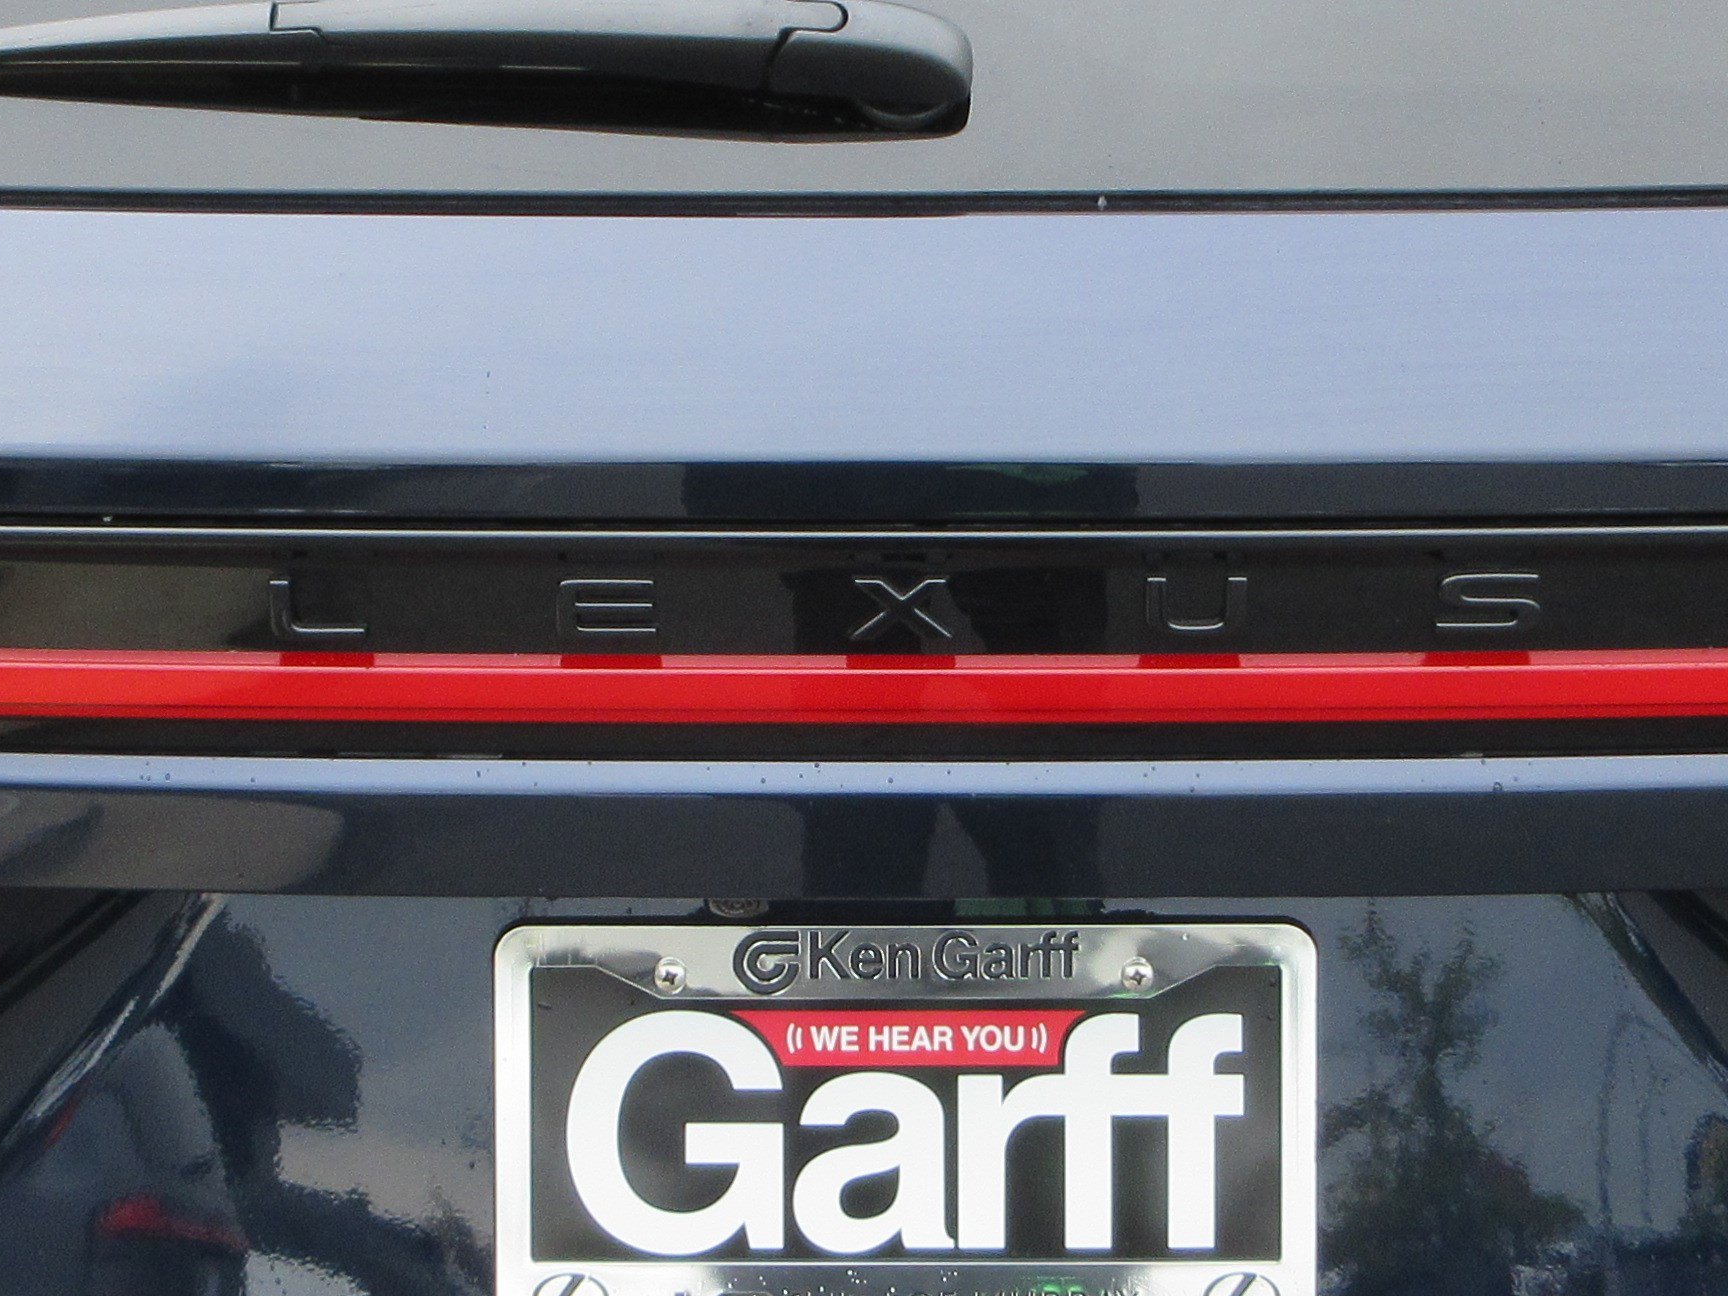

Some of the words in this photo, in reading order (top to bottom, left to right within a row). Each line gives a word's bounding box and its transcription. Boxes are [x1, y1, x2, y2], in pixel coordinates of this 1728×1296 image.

[268, 570, 1542, 645] LEXUS
[807, 927, 921, 981] Ken
[931, 928, 1081, 981] Garff
[810, 1025, 860, 1053] WE
[868, 1025, 953, 1053] HEAR
[961, 1024, 1025, 1053] YOU
[565, 1008, 1246, 1257] Garff
